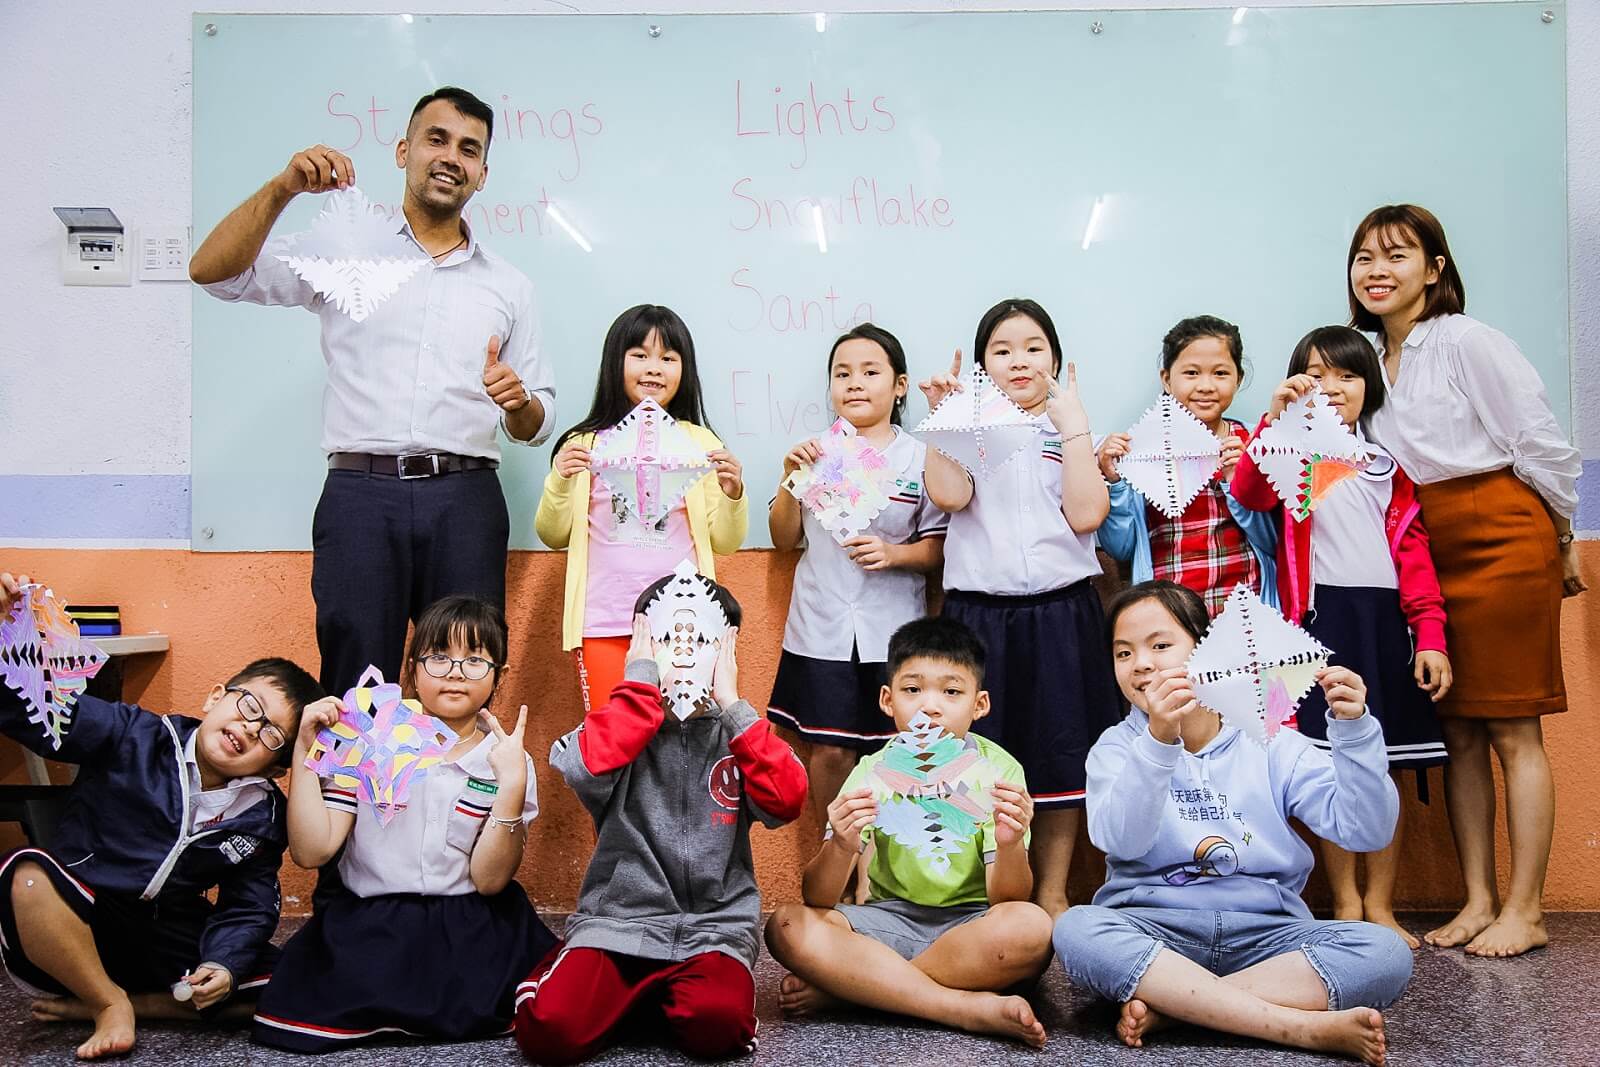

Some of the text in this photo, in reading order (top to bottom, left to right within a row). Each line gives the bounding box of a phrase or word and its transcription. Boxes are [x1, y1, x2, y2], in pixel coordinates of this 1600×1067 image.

[327, 92, 603, 183] Stings
[736, 79, 896, 170] Lights
[729, 175, 955, 232] Snowflake
[727, 268, 874, 333] Santa
[732, 370, 835, 437] Elve
[576, 649, 591, 712] adidas
